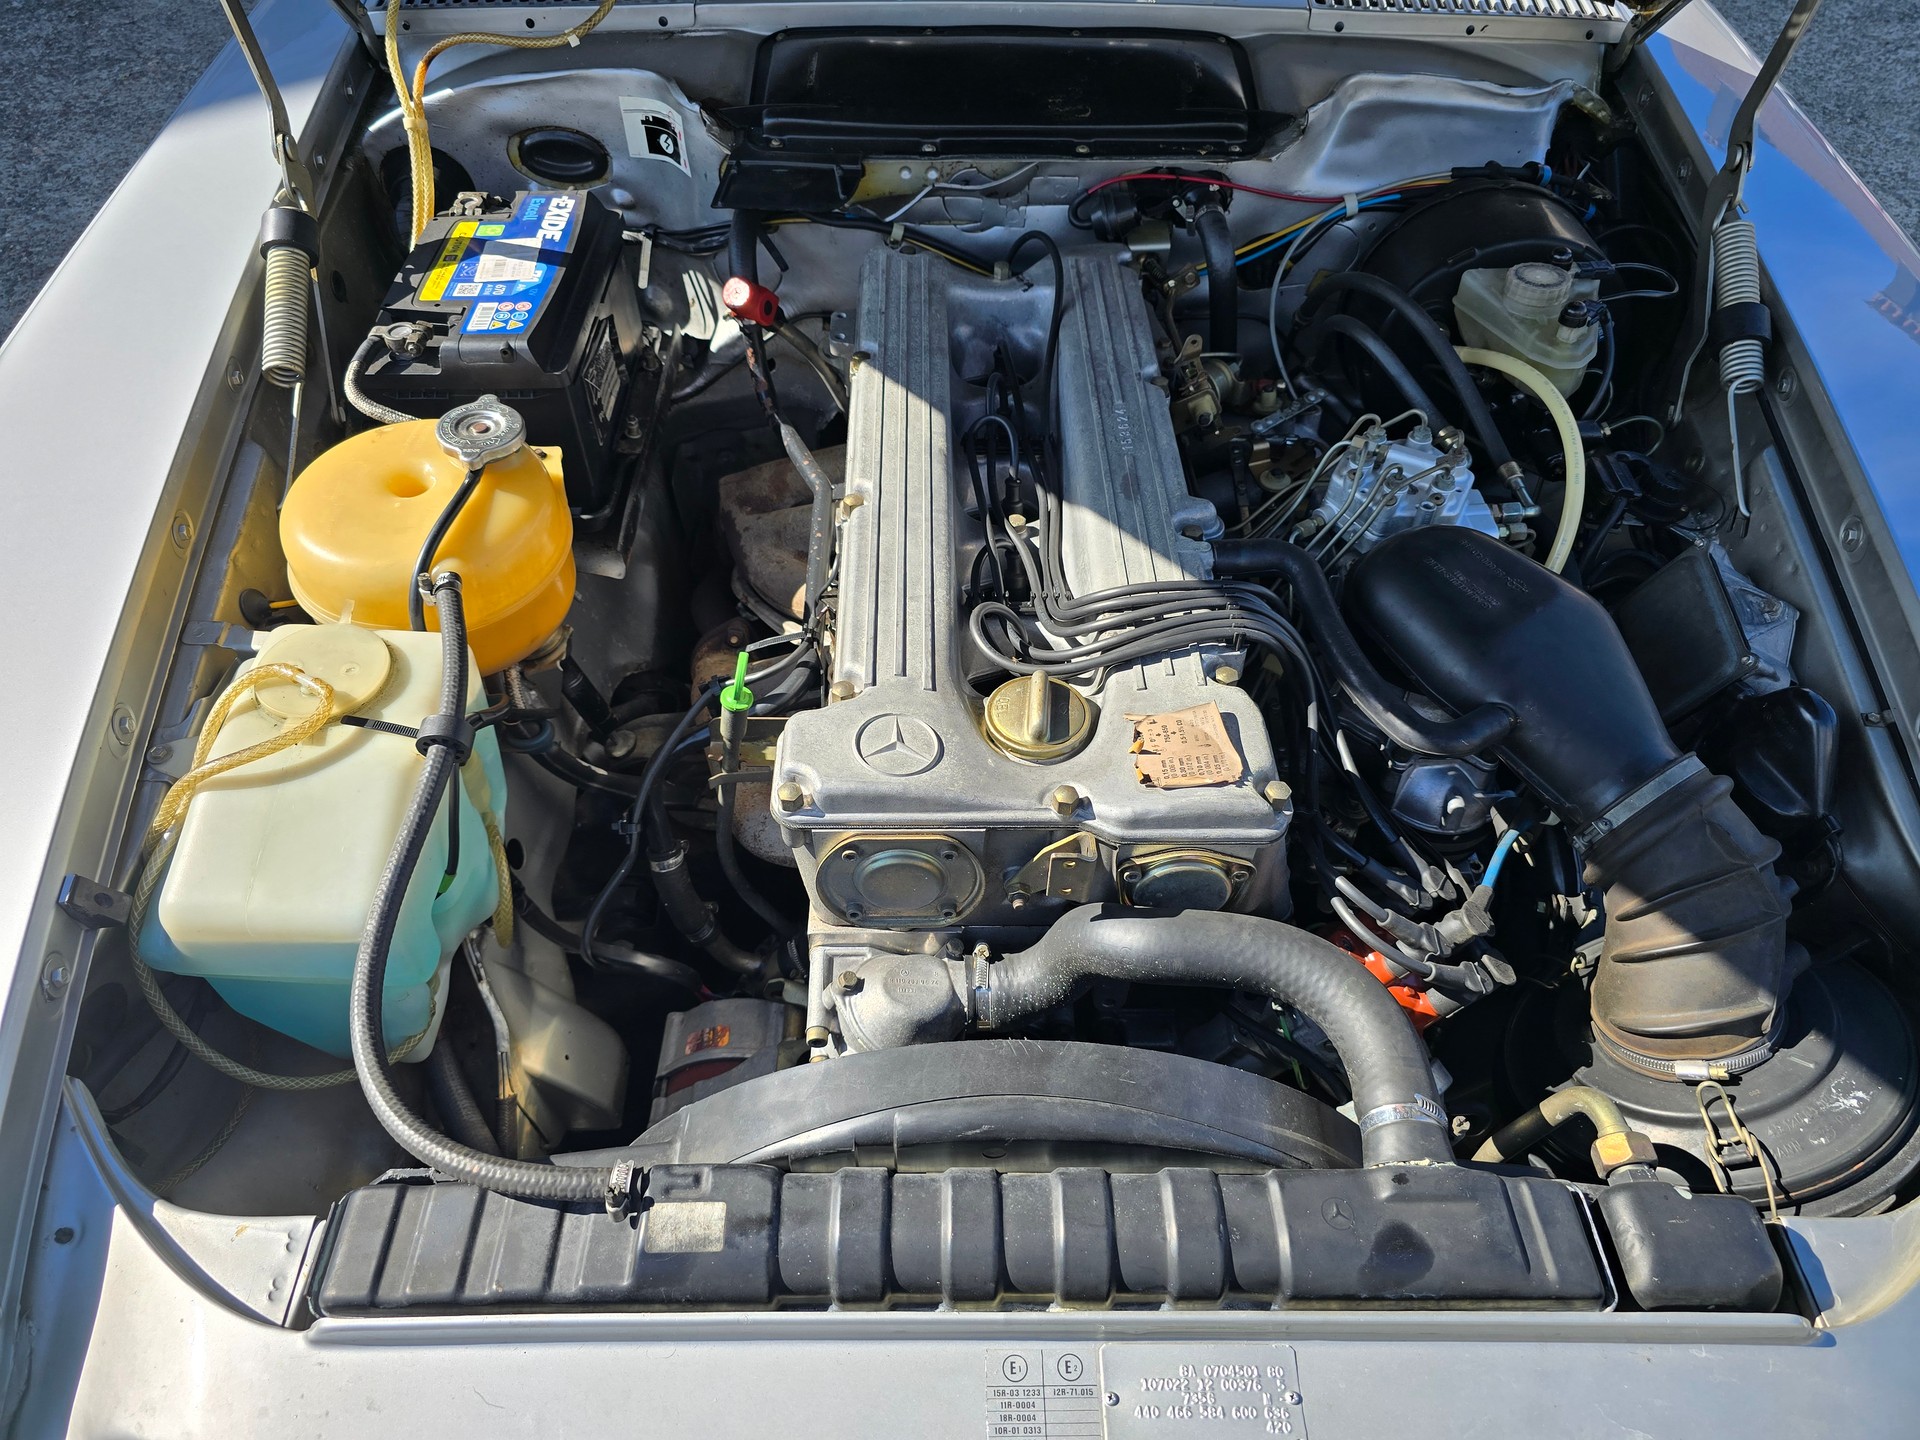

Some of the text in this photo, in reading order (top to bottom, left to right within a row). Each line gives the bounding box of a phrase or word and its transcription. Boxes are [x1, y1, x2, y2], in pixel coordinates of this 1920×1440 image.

[522, 197, 547, 221] Excell
[536, 196, 576, 243] EXIDE
[492, 283, 507, 296] 670
[1140, 1377, 1190, 1392] 107022
[1196, 1378, 1214, 1392] 12
[993, 1389, 1041, 1397] 15R-03 1233
[1053, 1388, 1094, 1396] 12R-71.015
[1000, 1401, 1036, 1409] 11R-0004
[999, 1414, 1036, 1422] 18R-0004
[1134, 1405, 1160, 1419] 440
[1166, 1405, 1193, 1419] 466
[1199, 1405, 1226, 1419] 584
[1231, 1406, 1258, 1419] 600
[994, 1426, 1042, 1435] 10R-01 0313
[1266, 1420, 1292, 1434] 420
